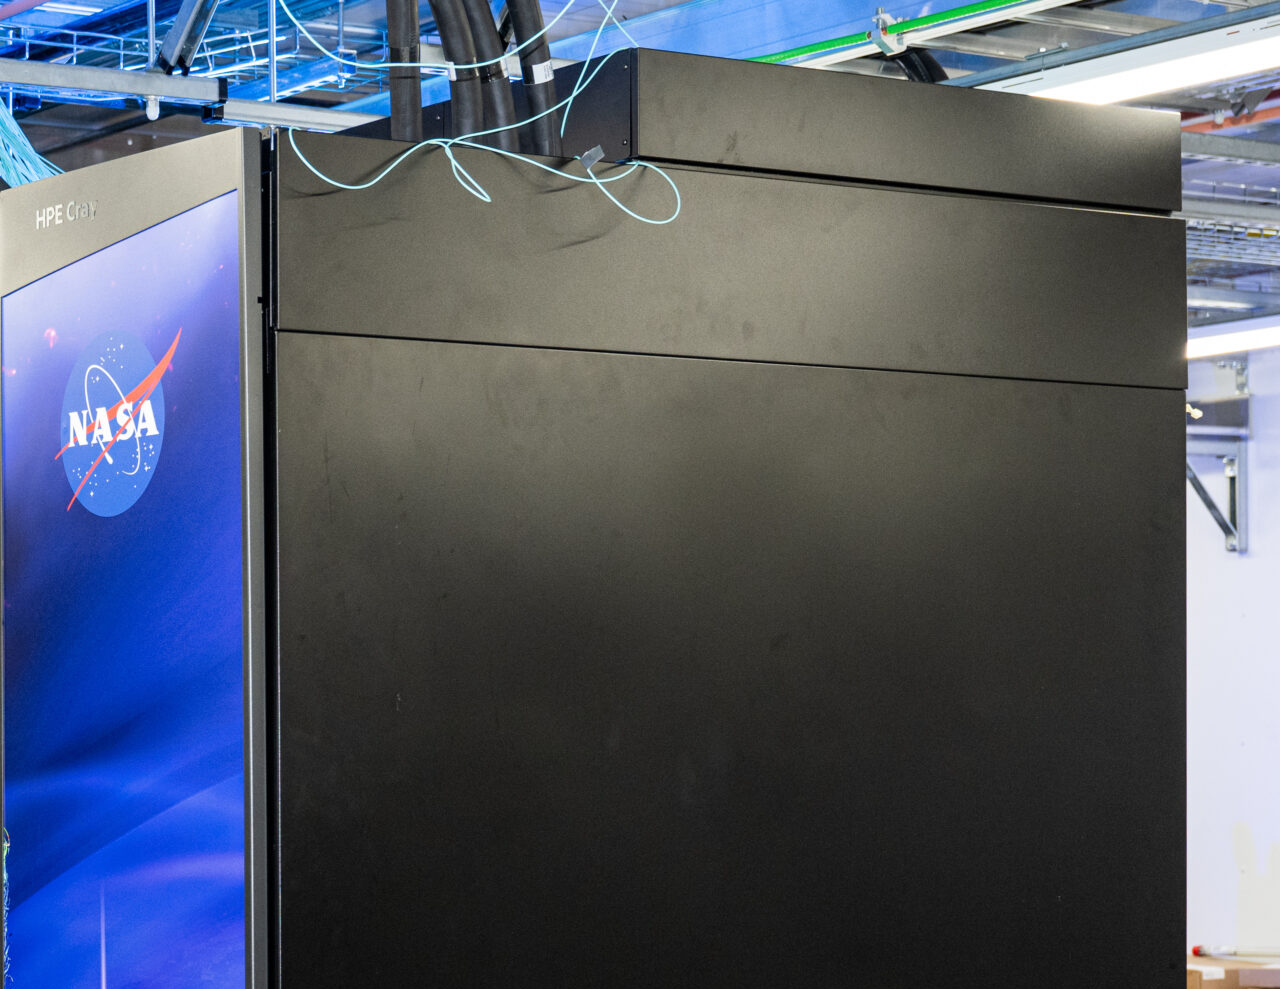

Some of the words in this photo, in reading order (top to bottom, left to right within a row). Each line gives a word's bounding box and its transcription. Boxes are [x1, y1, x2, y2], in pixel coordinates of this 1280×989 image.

[35, 203, 63, 230] HPE
[66, 200, 98, 221] Cray
[68, 399, 160, 448] NASA
